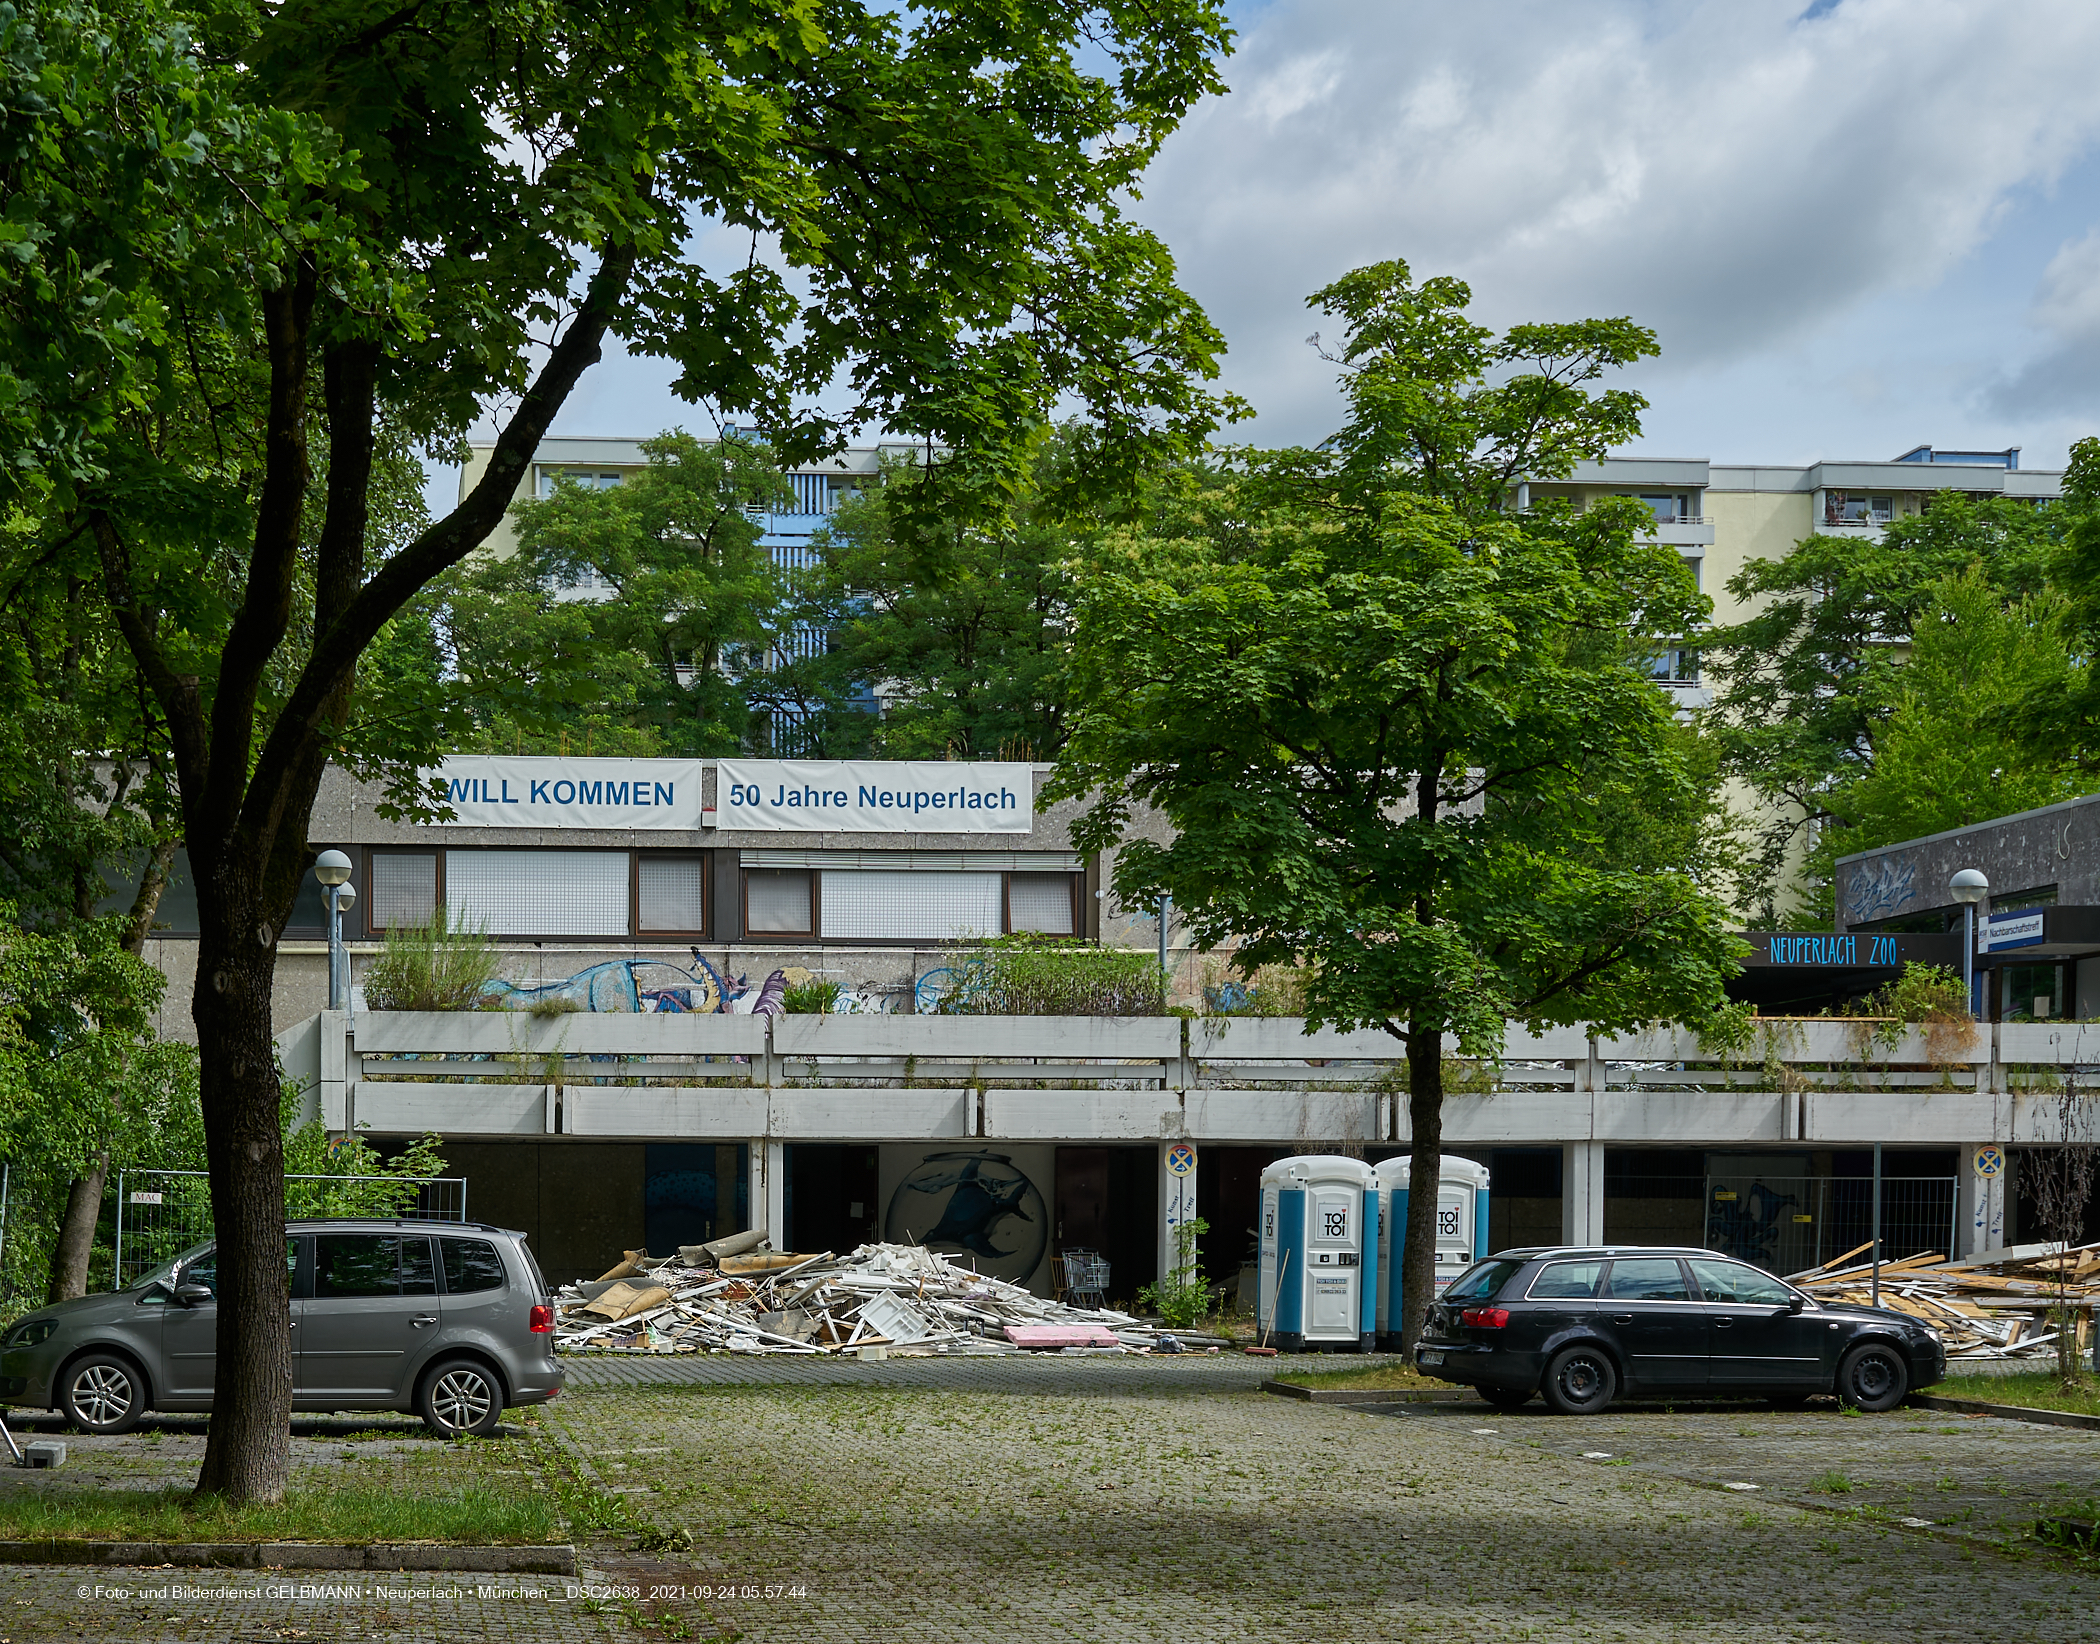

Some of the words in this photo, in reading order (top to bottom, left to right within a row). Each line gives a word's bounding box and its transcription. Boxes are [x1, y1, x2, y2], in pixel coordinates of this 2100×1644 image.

[443, 778, 519, 803] WILL
[530, 779, 674, 806] KOMMEN
[729, 784, 761, 807] 50
[770, 784, 848, 808] Jahre
[858, 785, 1017, 814] Neuperlach
[1989, 920, 2040, 938] Nachbarschaftstreff
[1770, 935, 1856, 965] NEUPERLACH
[1869, 936, 1897, 966] ZOO
[135, 1193, 159, 1202] MAC
[1324, 1212, 1346, 1225] TOI
[1438, 1211, 1459, 1223] TOI
[1324, 1224, 1345, 1236] TOI
[1437, 1223, 1459, 1235] TOI
